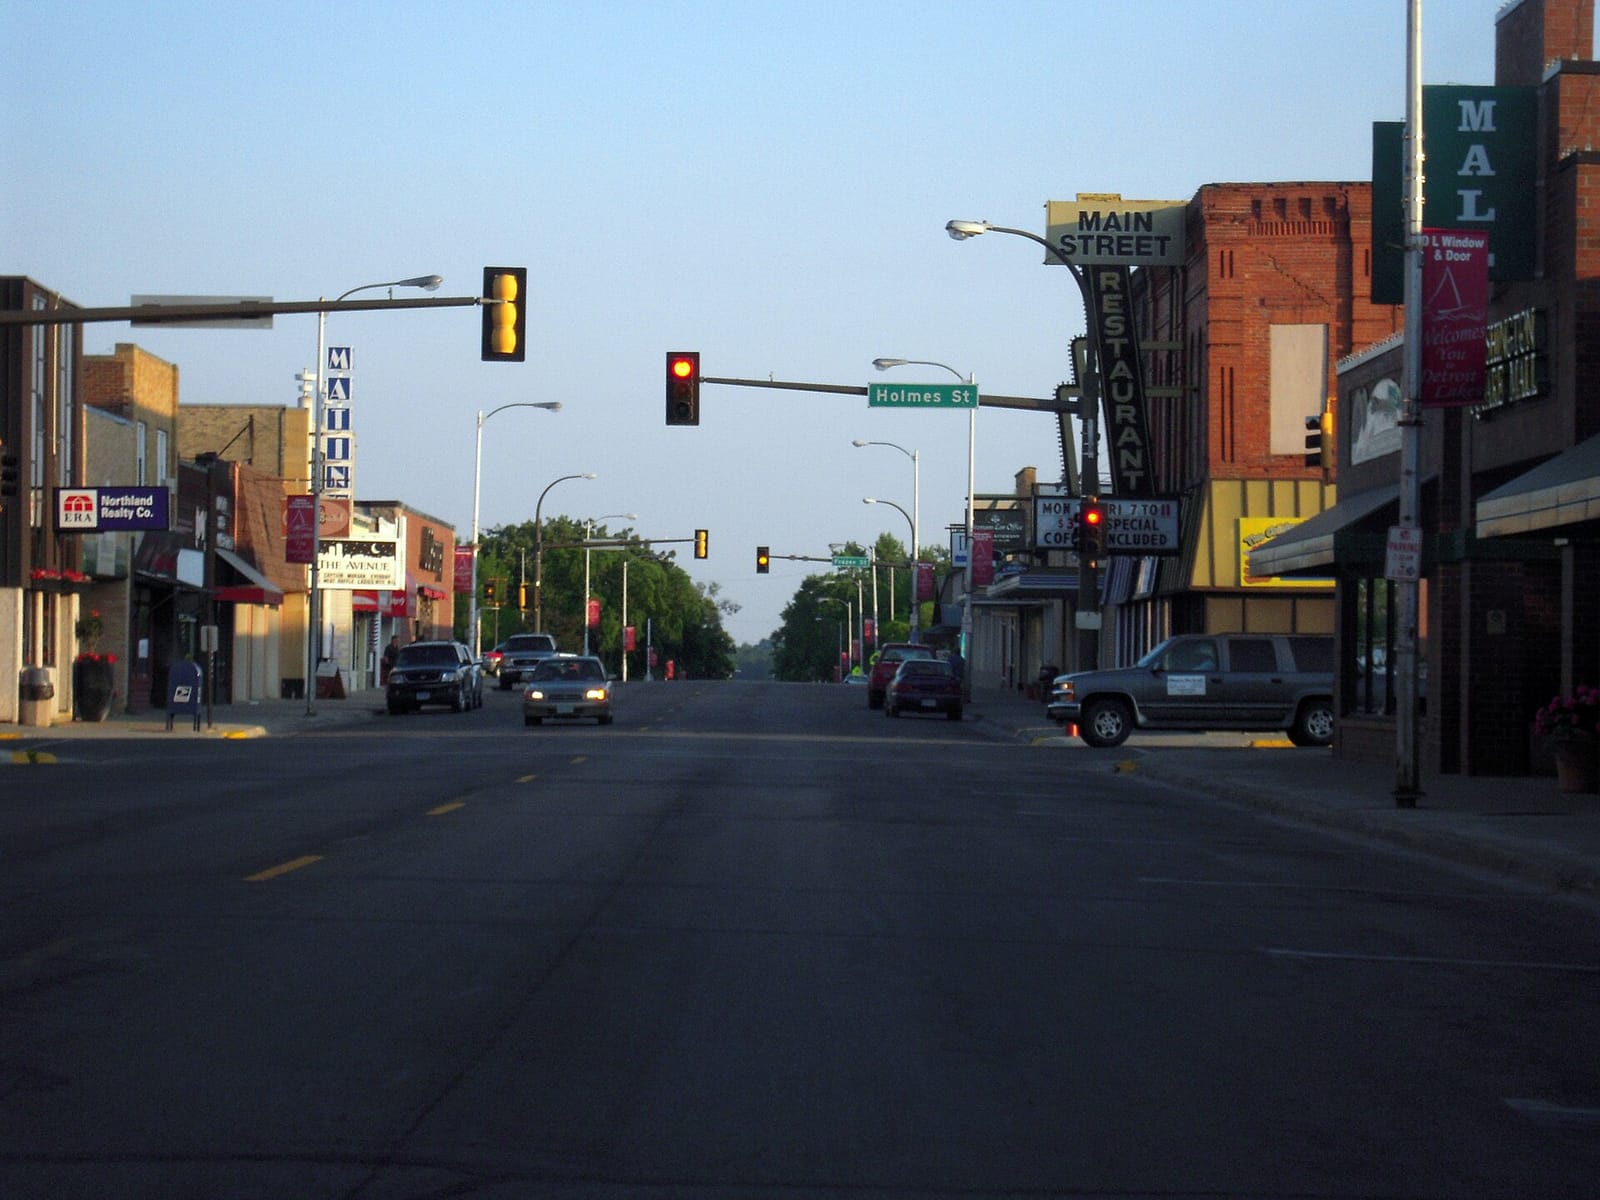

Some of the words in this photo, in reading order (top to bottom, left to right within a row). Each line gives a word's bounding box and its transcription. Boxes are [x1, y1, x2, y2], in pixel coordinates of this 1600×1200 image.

[1456, 99, 1497, 267] MAL
[1077, 210, 1154, 233] MAIN
[1059, 234, 1172, 257] STREET
[1431, 236, 1440, 248] L
[1441, 235, 1486, 249] Window
[1433, 249, 1443, 261] &
[1445, 249, 1472, 262] Door
[1100, 271, 1145, 491] RESTAURANT
[876, 389, 942, 403] Holmes
[952, 390, 971, 403] St
[328, 347, 350, 498] MATIN
[101, 495, 154, 507] Northland
[101, 507, 135, 520] Realty
[136, 506, 154, 518] Co.
[1042, 503, 1071, 515] MON
[1107, 503, 1122, 516] RI
[1130, 504, 1138, 516] 7
[1143, 504, 1159, 516] TO
[64, 513, 93, 523] ERA
[1106, 518, 1160, 531] SPECIAL
[1107, 533, 1168, 546] NCLUDED
[319, 560, 341, 569] THE
[346, 561, 390, 571] AVENUE
